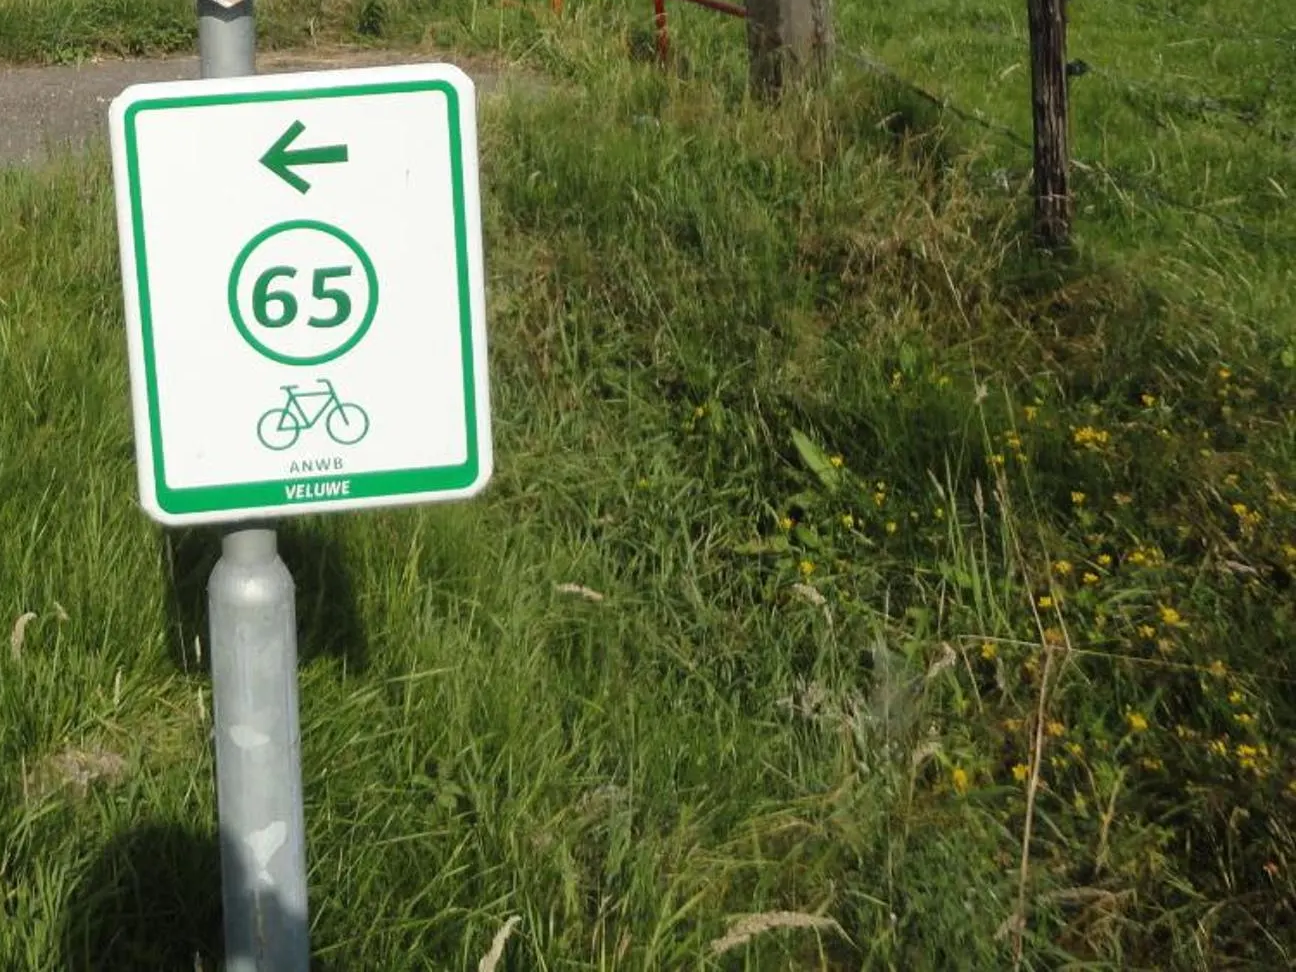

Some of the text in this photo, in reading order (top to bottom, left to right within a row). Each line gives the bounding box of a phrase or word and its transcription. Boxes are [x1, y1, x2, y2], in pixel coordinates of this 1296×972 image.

[252, 265, 352, 328] 65
[289, 457, 344, 473] ANWB
[284, 480, 351, 499] VELUWE
